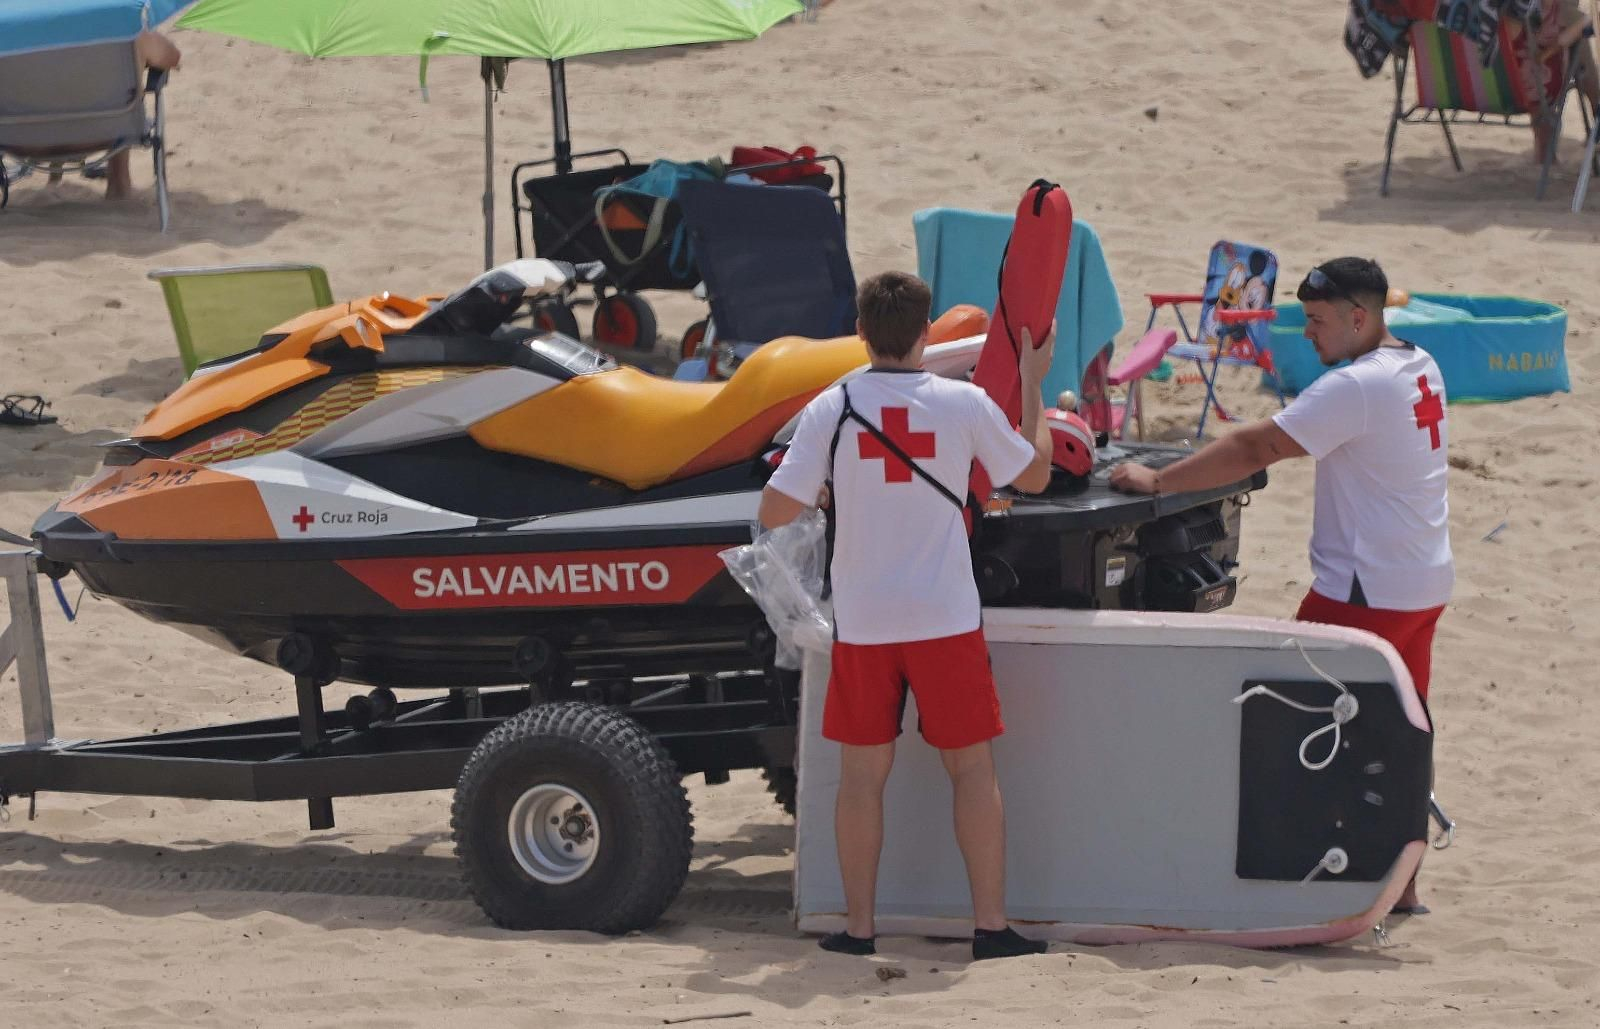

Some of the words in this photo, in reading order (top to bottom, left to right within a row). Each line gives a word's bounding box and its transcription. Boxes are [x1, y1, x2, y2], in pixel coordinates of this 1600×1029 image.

[321, 511, 353, 524] Cruz
[357, 509, 388, 525] Roja
[412, 560, 670, 598] SALVAMENTO
